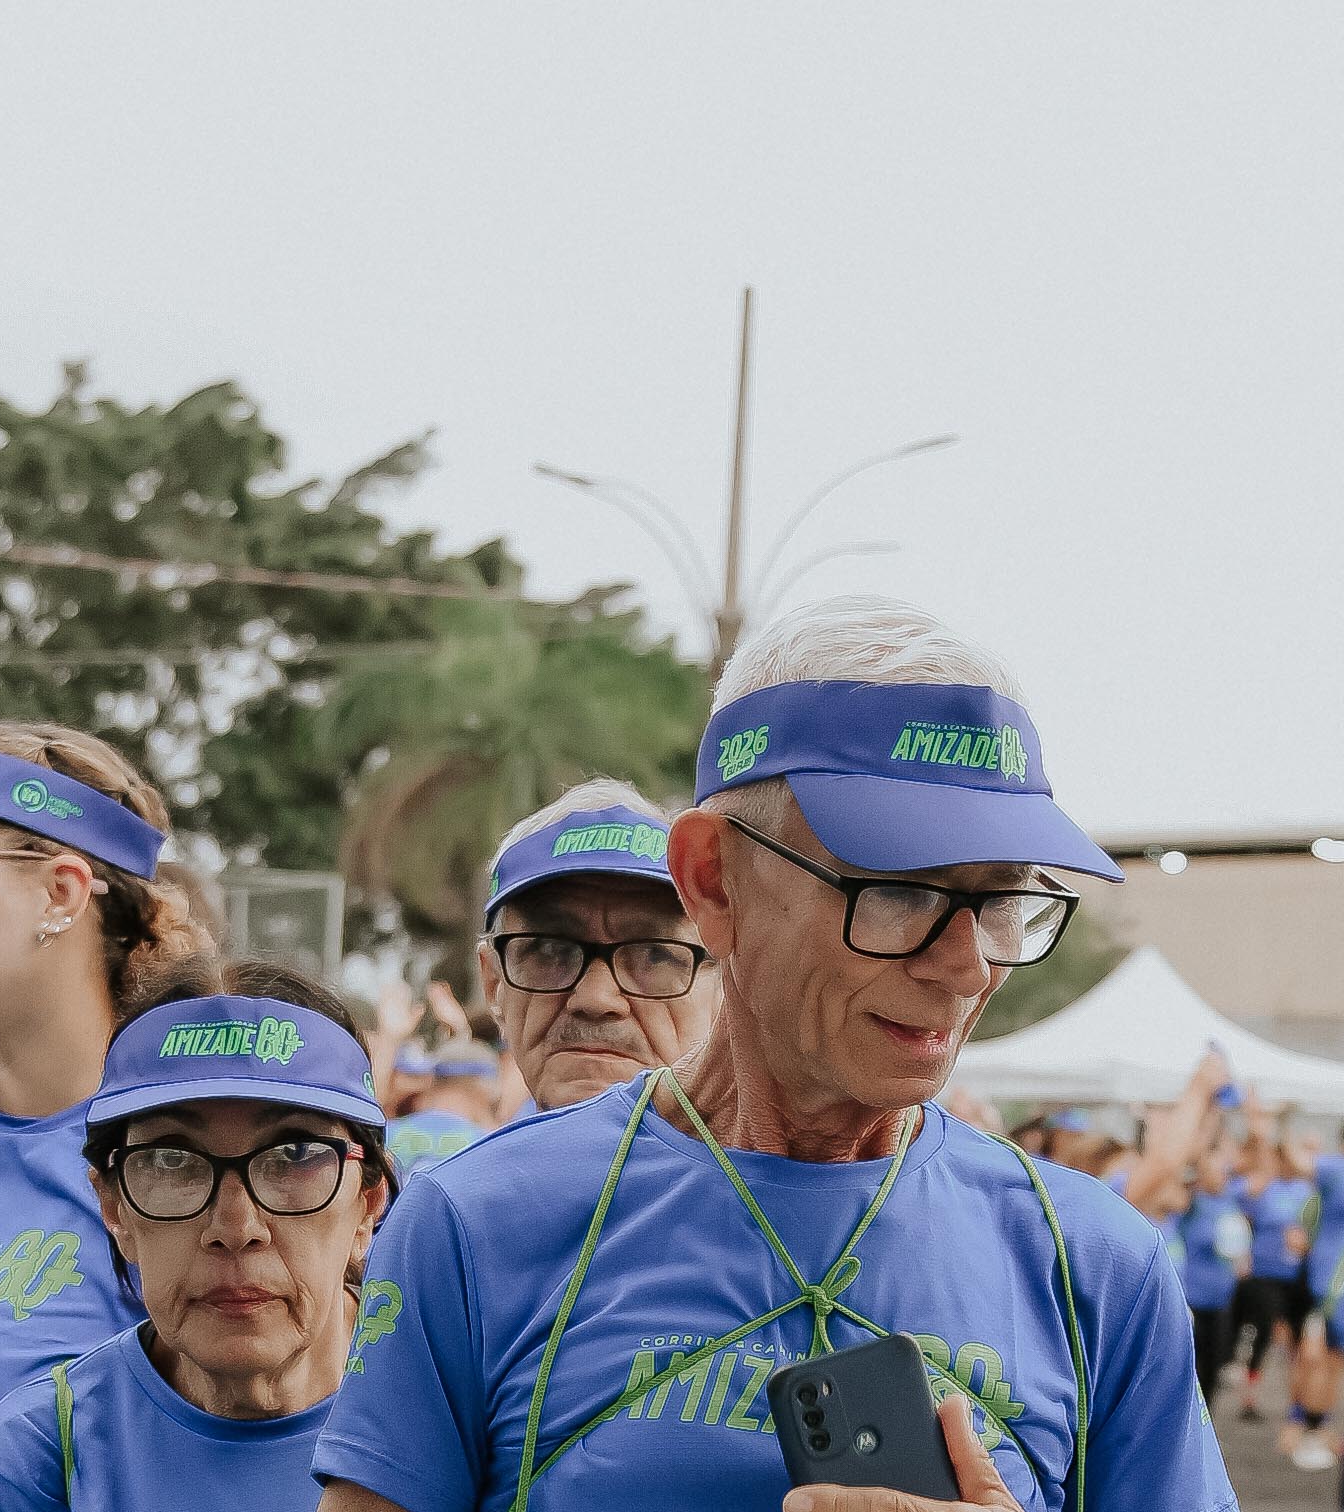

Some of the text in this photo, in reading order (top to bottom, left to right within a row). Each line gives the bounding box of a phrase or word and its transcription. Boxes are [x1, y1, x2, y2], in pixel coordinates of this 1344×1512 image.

[717, 725, 770, 768] 2026
[890, 729, 1001, 771] AMIZADE
[552, 829, 631, 859] AMIZADE
[159, 1027, 257, 1059] AMIZADE
[606, 1350, 778, 1434] AMIZ
